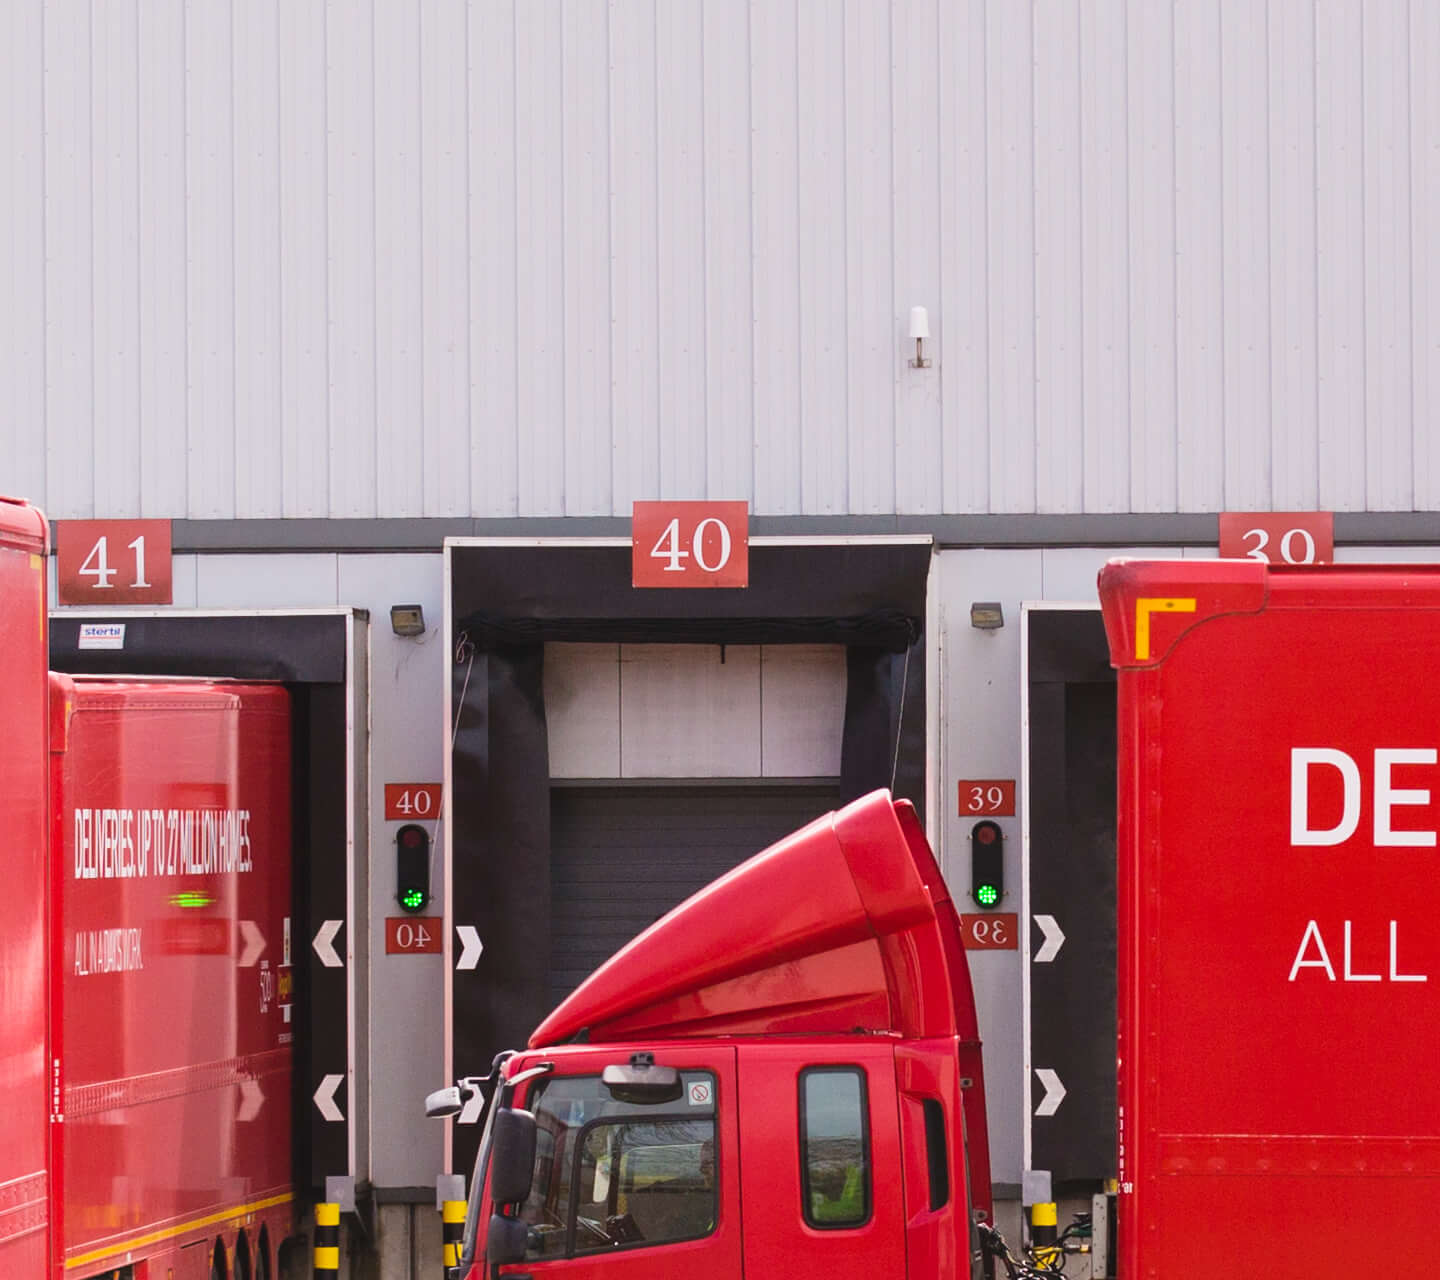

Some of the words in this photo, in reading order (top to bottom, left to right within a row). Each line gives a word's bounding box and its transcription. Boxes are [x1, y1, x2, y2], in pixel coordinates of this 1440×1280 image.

[78, 535, 152, 588] 41
[650, 517, 731, 572] 40
[395, 790, 431, 814] 40
[967, 786, 1003, 811] 39
[1288, 919, 1428, 982] ALL
